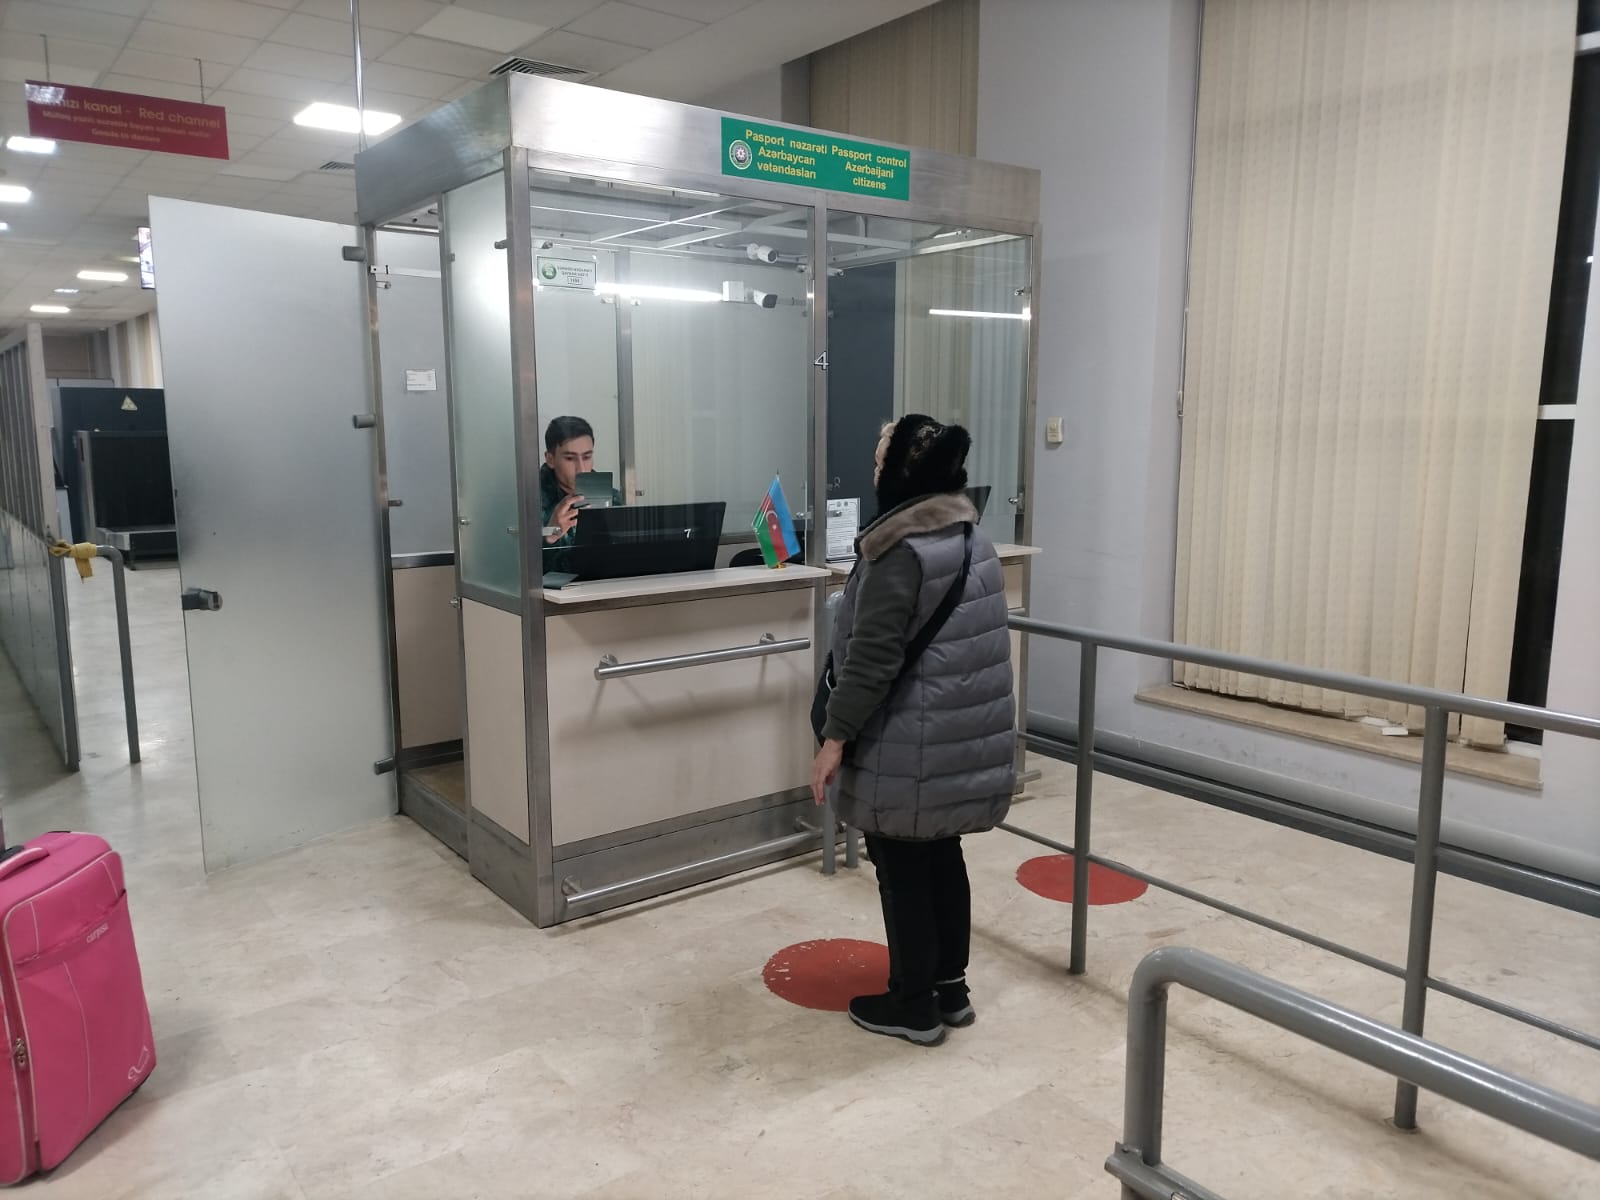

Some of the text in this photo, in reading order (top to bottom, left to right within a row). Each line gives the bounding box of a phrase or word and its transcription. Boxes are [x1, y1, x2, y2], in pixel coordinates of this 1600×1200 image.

[83, 100, 122, 114] kanal
[138, 107, 164, 121] Red
[167, 112, 220, 129] channel
[745, 128, 785, 146] Pasport
[831, 144, 907, 168] Passport control
[845, 161, 894, 178] Azerbaijani
[852, 177, 887, 191] citizens
[814, 350, 829, 370] 4
